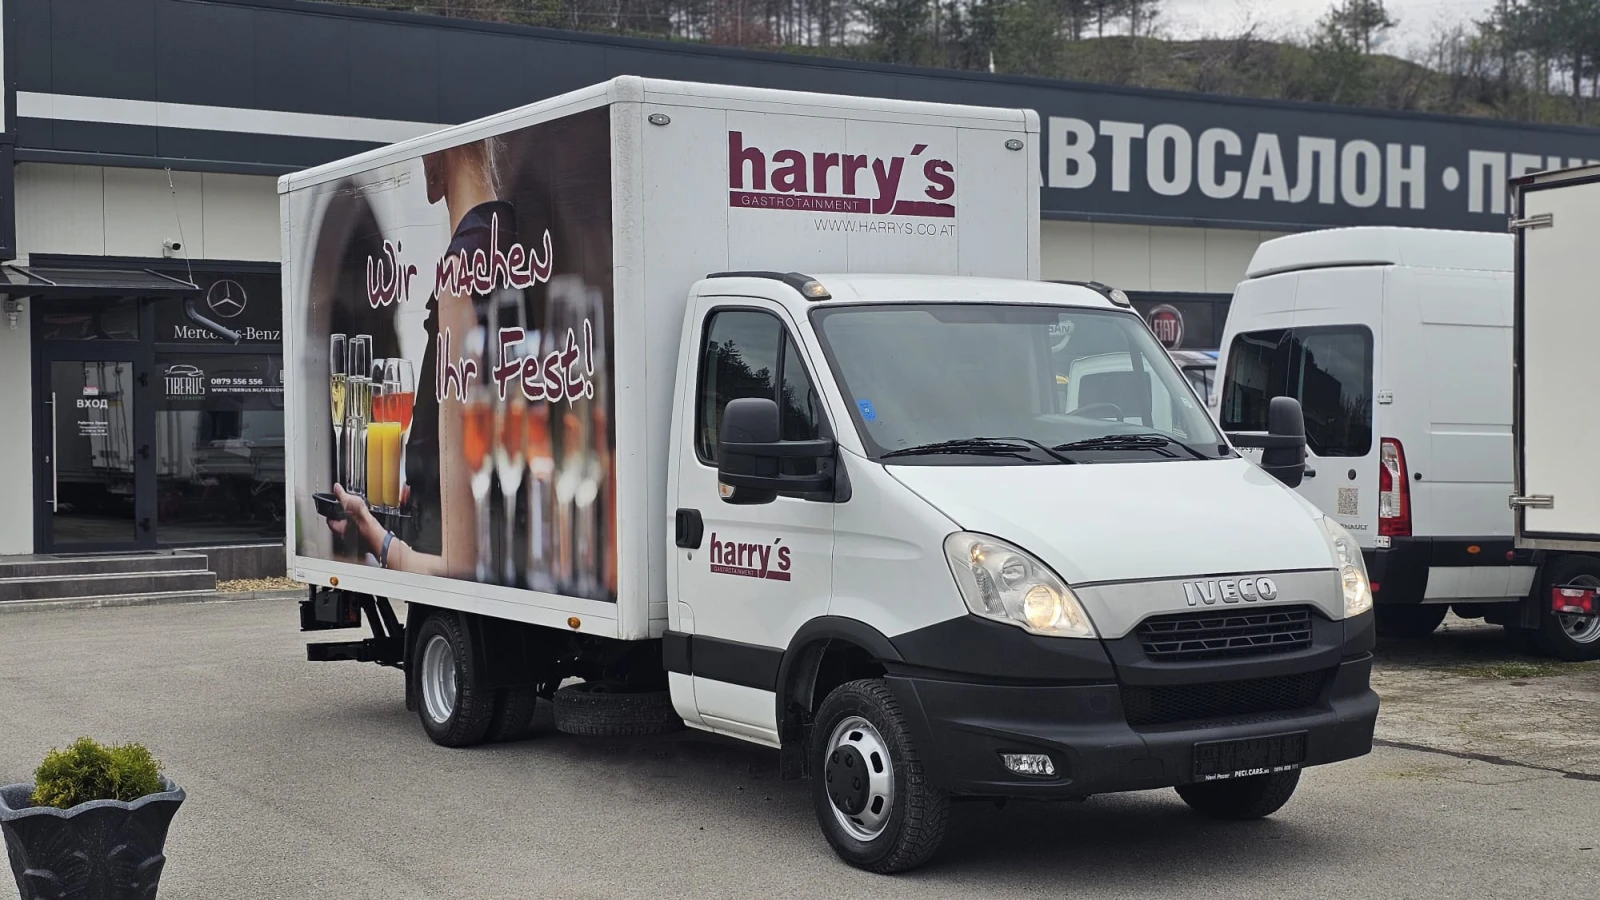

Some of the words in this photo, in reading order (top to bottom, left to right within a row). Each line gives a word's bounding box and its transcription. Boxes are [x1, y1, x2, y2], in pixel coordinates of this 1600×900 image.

[1040, 116, 1425, 210] ВТОСАЛОН
[741, 195, 860, 211] GASTROTAINMENT
[814, 218, 956, 237] WWW.HARRYS.CO.AT
[366, 239, 418, 309] Wir
[1048, 324, 1070, 334] SAN
[1153, 319, 1177, 342] FIAT
[492, 317, 595, 409] Fest!
[164, 376, 206, 395] TIBERUS
[76, 399, 109, 409] ВХОД
[1340, 523, 1369, 531] NAULT
[1183, 577, 1278, 606] IVECO
